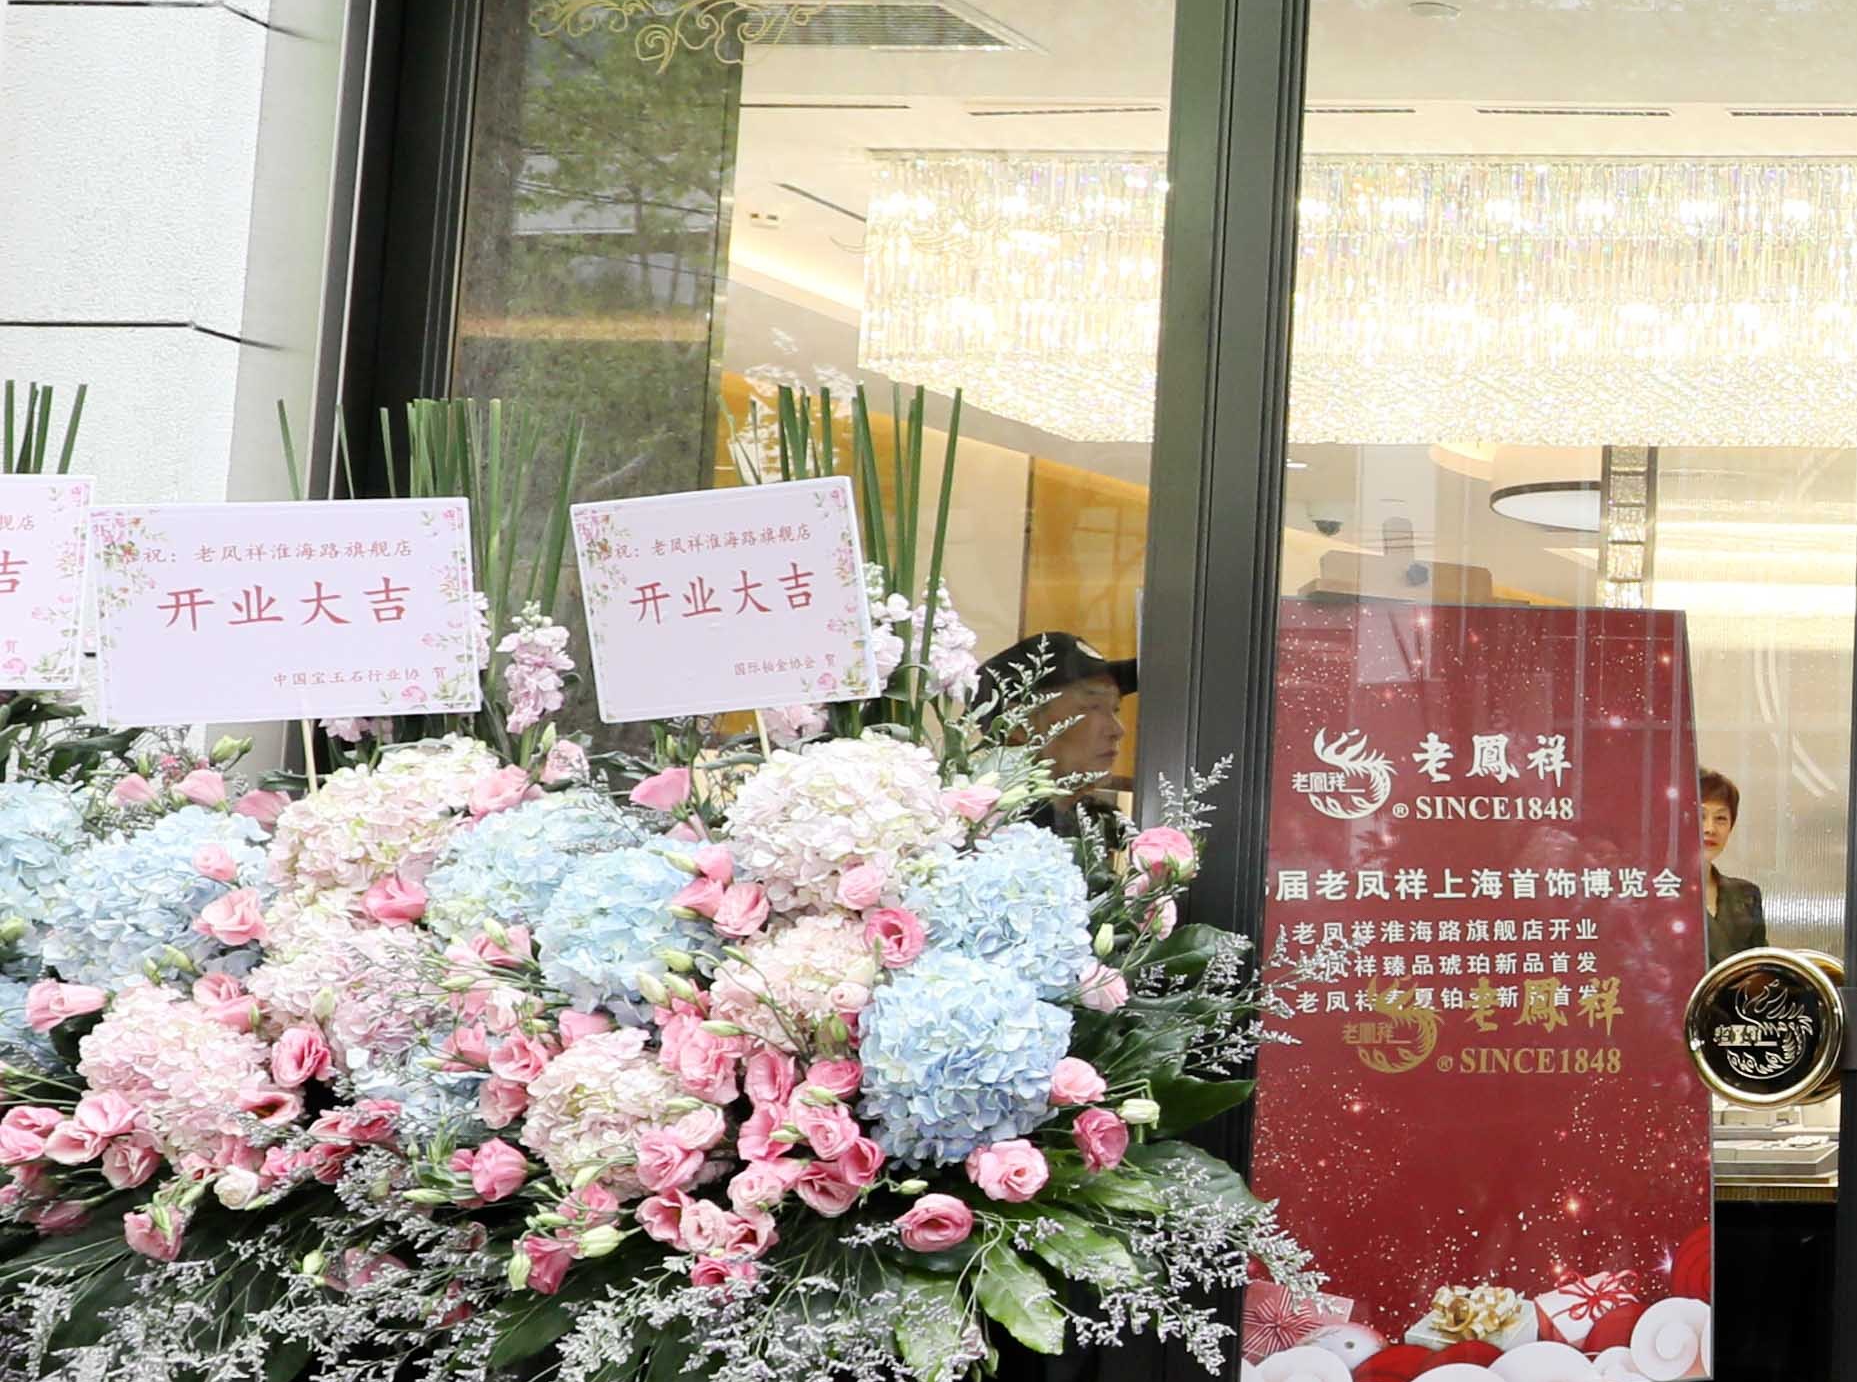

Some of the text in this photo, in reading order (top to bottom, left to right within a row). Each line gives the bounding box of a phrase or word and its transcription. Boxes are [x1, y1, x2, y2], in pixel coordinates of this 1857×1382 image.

[156, 576, 412, 633] 开业大吉
[629, 562, 815, 625] 开业大吉
[1411, 731, 1573, 788] 老鳳祥
[1263, 867, 1683, 902] 届老凤祥上海首饰博览会
[1291, 918, 1600, 946] 老凤祥淮海路旗舰店开业
